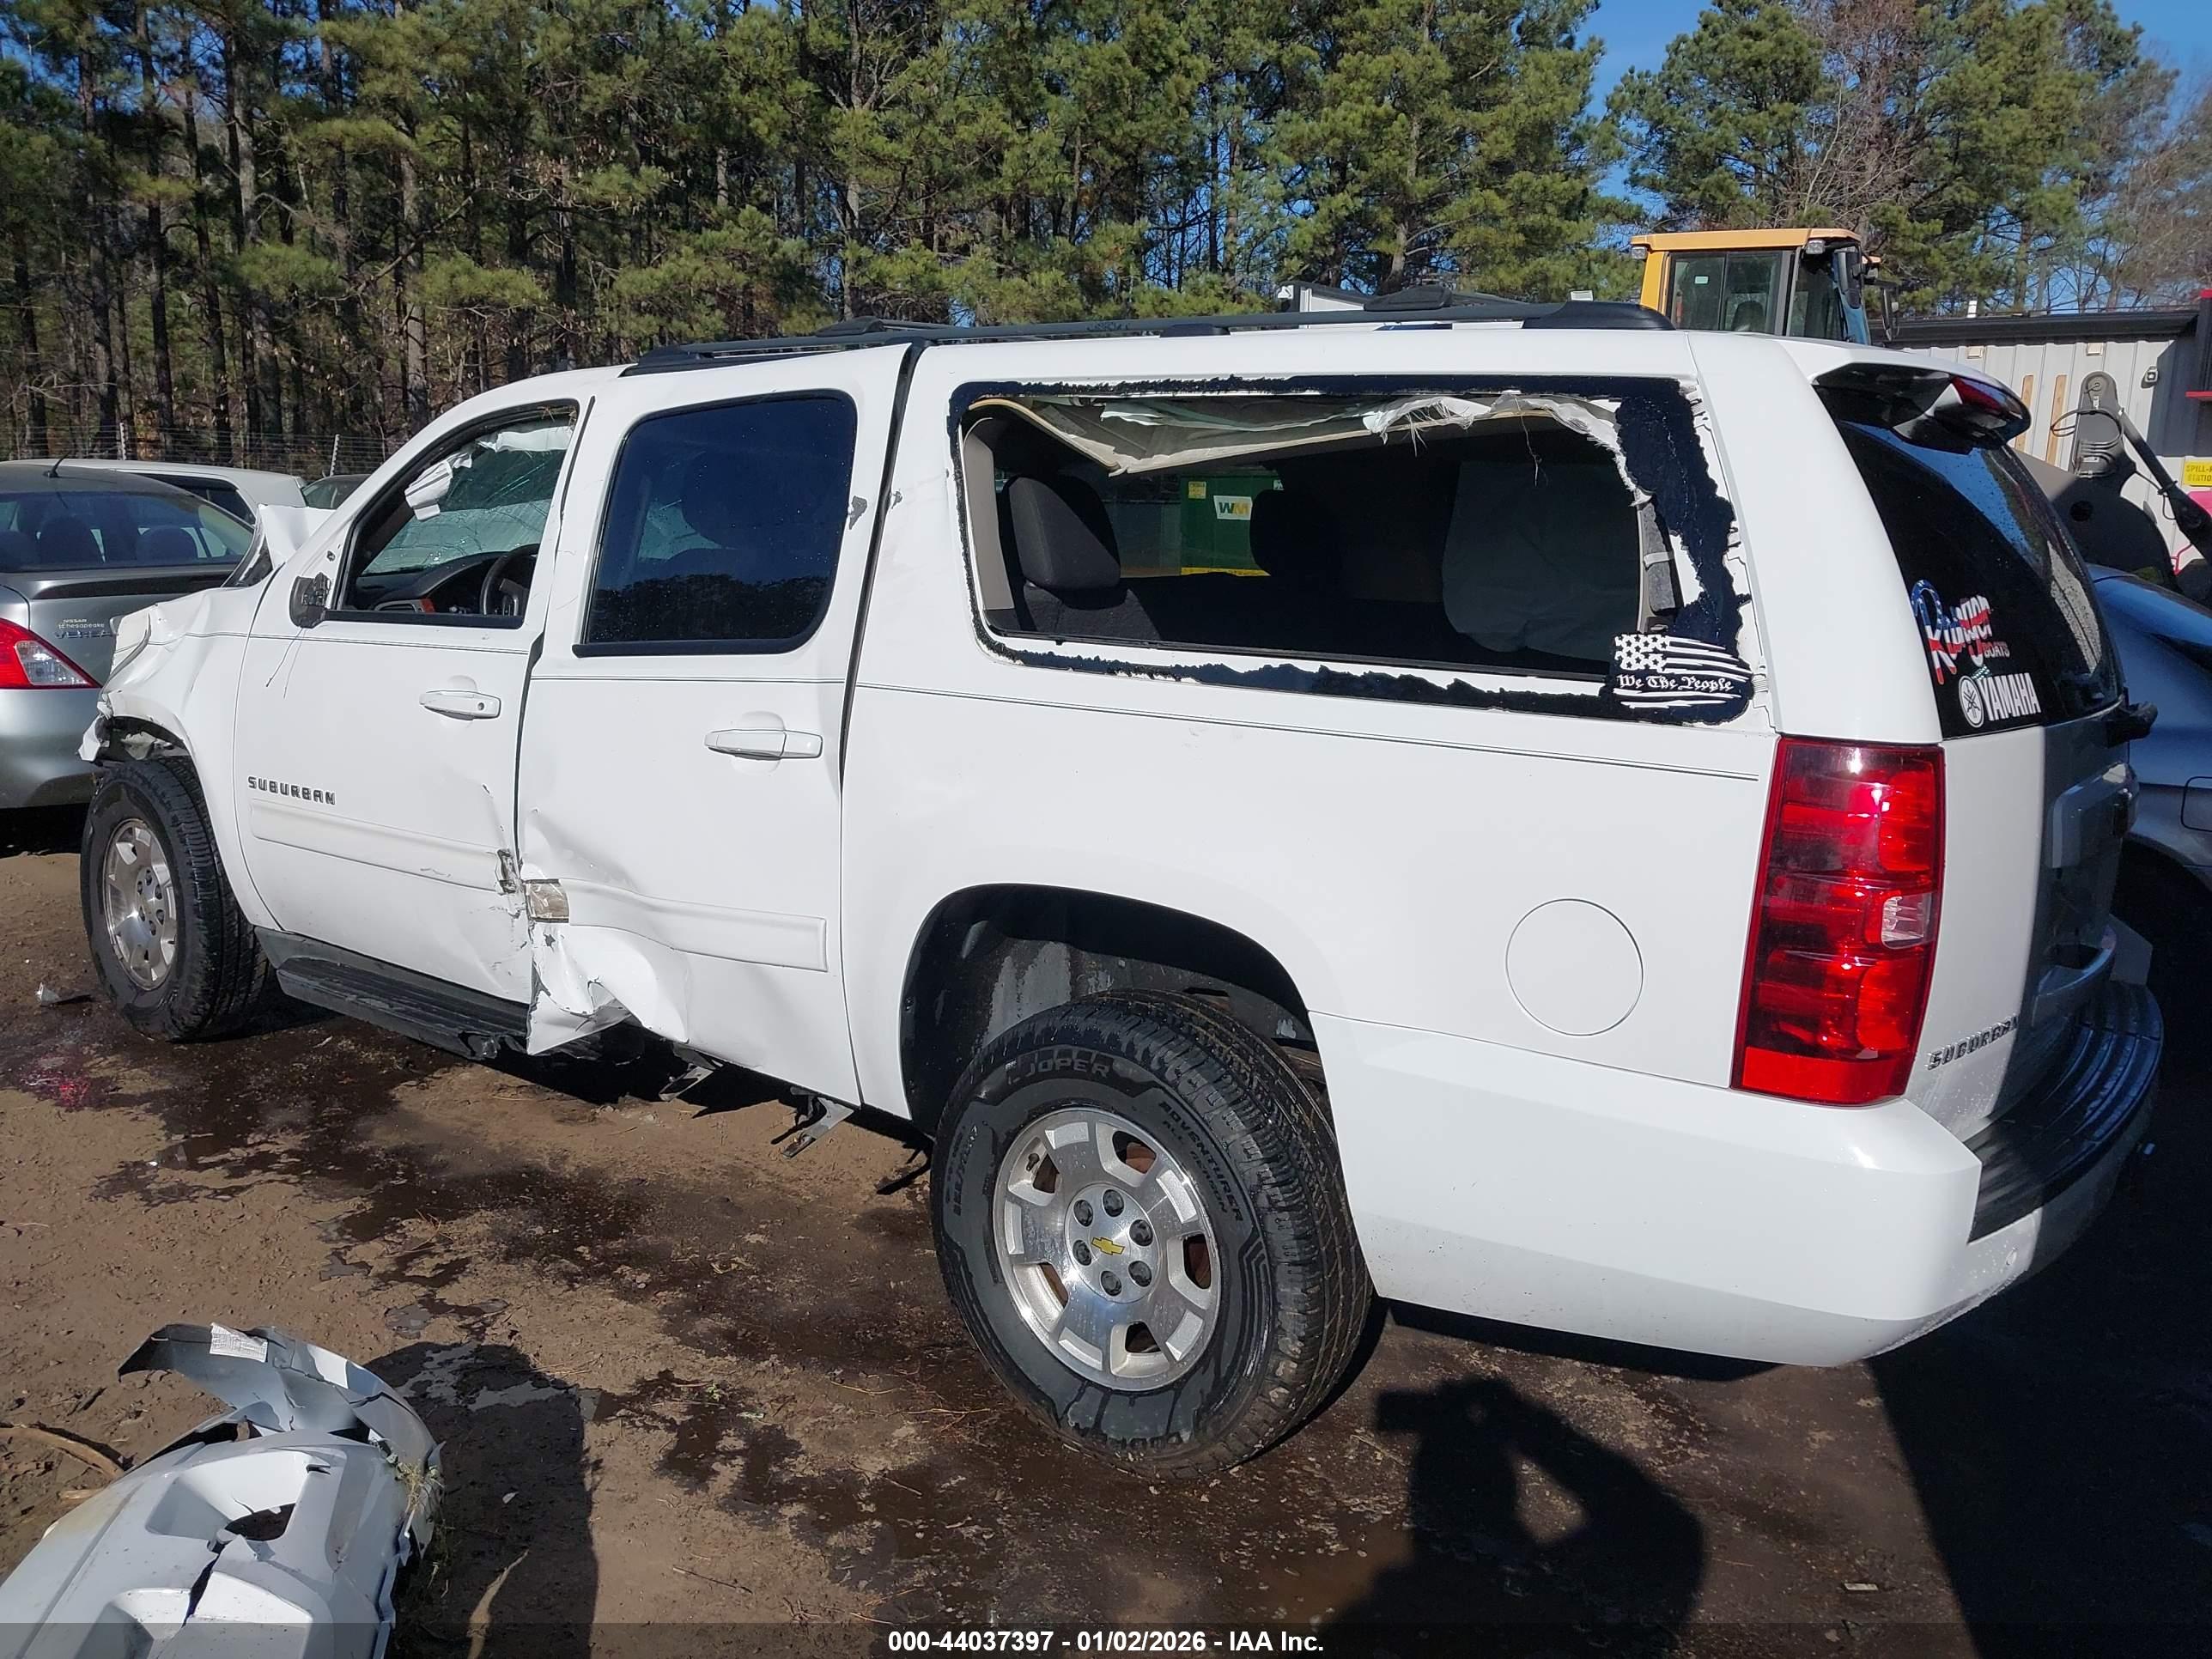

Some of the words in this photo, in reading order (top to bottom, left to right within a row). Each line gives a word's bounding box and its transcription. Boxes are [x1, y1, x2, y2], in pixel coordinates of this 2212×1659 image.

[1218, 501, 1249, 514] WM
[1618, 674, 1644, 689] We
[1645, 676, 1679, 690] The
[1677, 675, 1735, 693] People
[1977, 672, 2041, 721] YAMAHA
[247, 775, 336, 805] SUBURBAN
[1925, 1013, 2019, 1070] SUBURBAN
[1159, 1101, 1243, 1221] ADVENTURER
